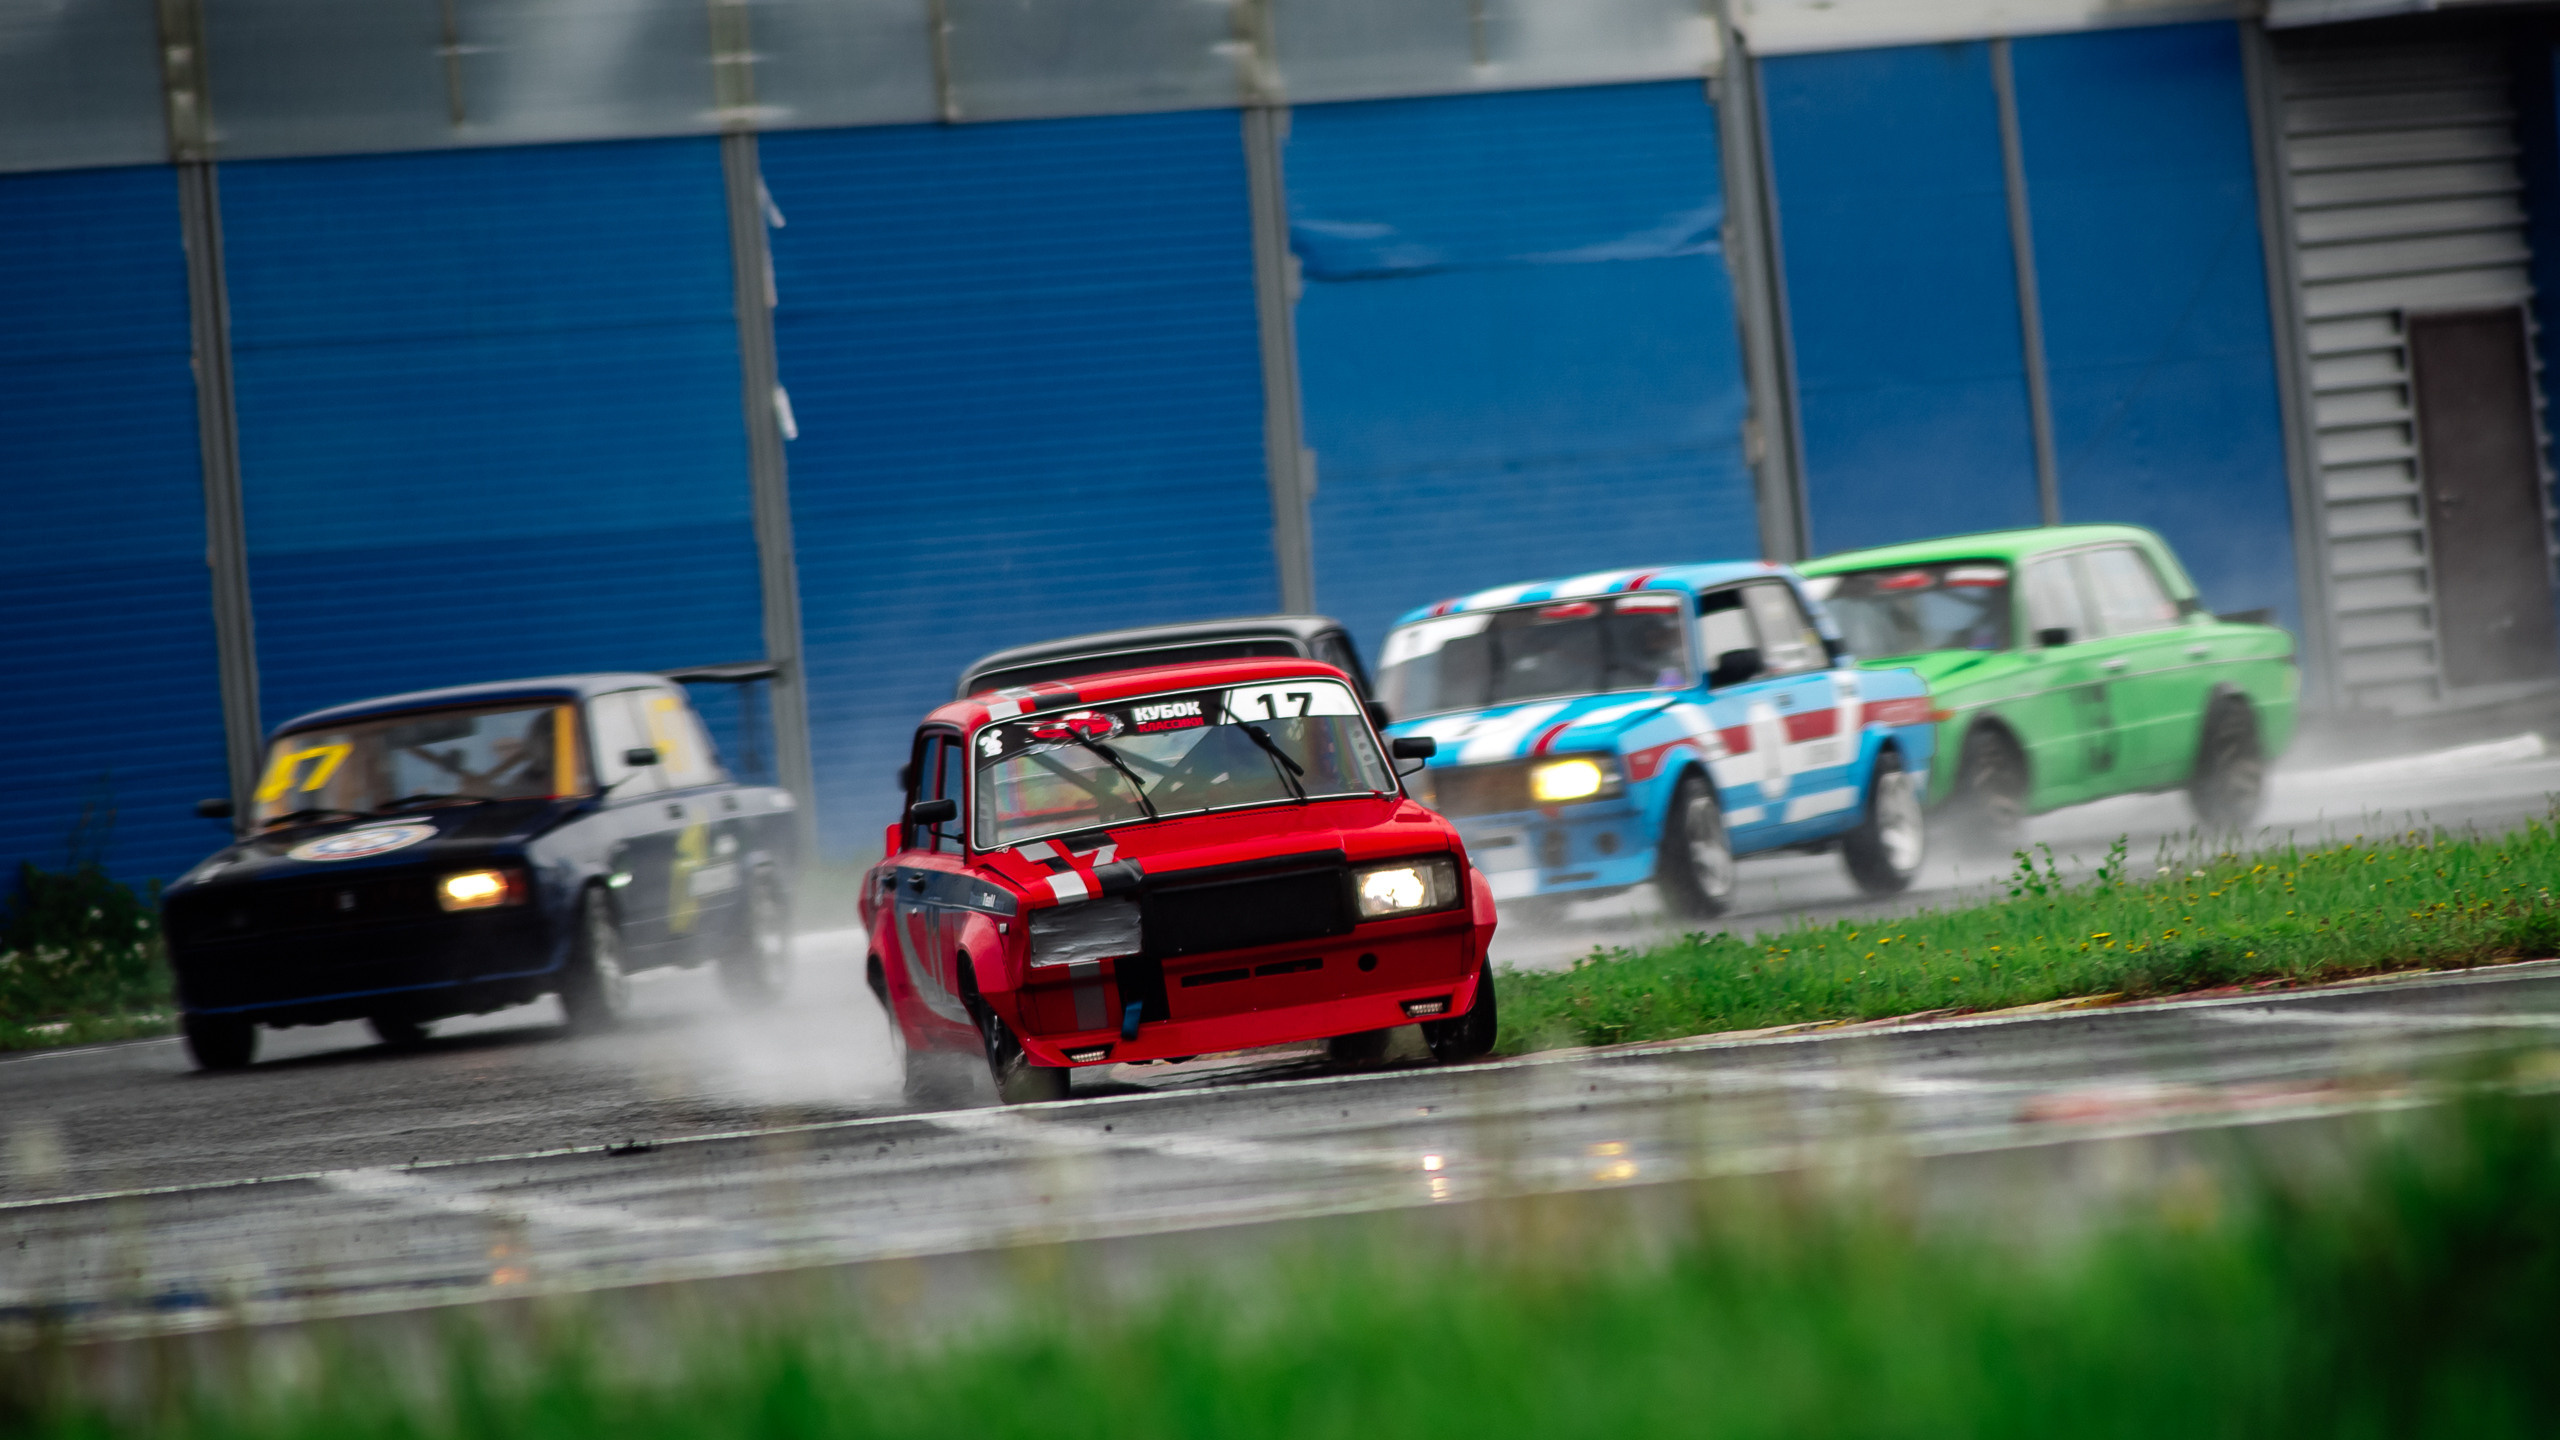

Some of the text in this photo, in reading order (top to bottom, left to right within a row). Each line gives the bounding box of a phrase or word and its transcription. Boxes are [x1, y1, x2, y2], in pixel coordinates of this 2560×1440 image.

[1133, 701, 1202, 722] КУБОК
[1257, 692, 1313, 720] 17
[1138, 717, 1204, 733] КЛАССИКИ
